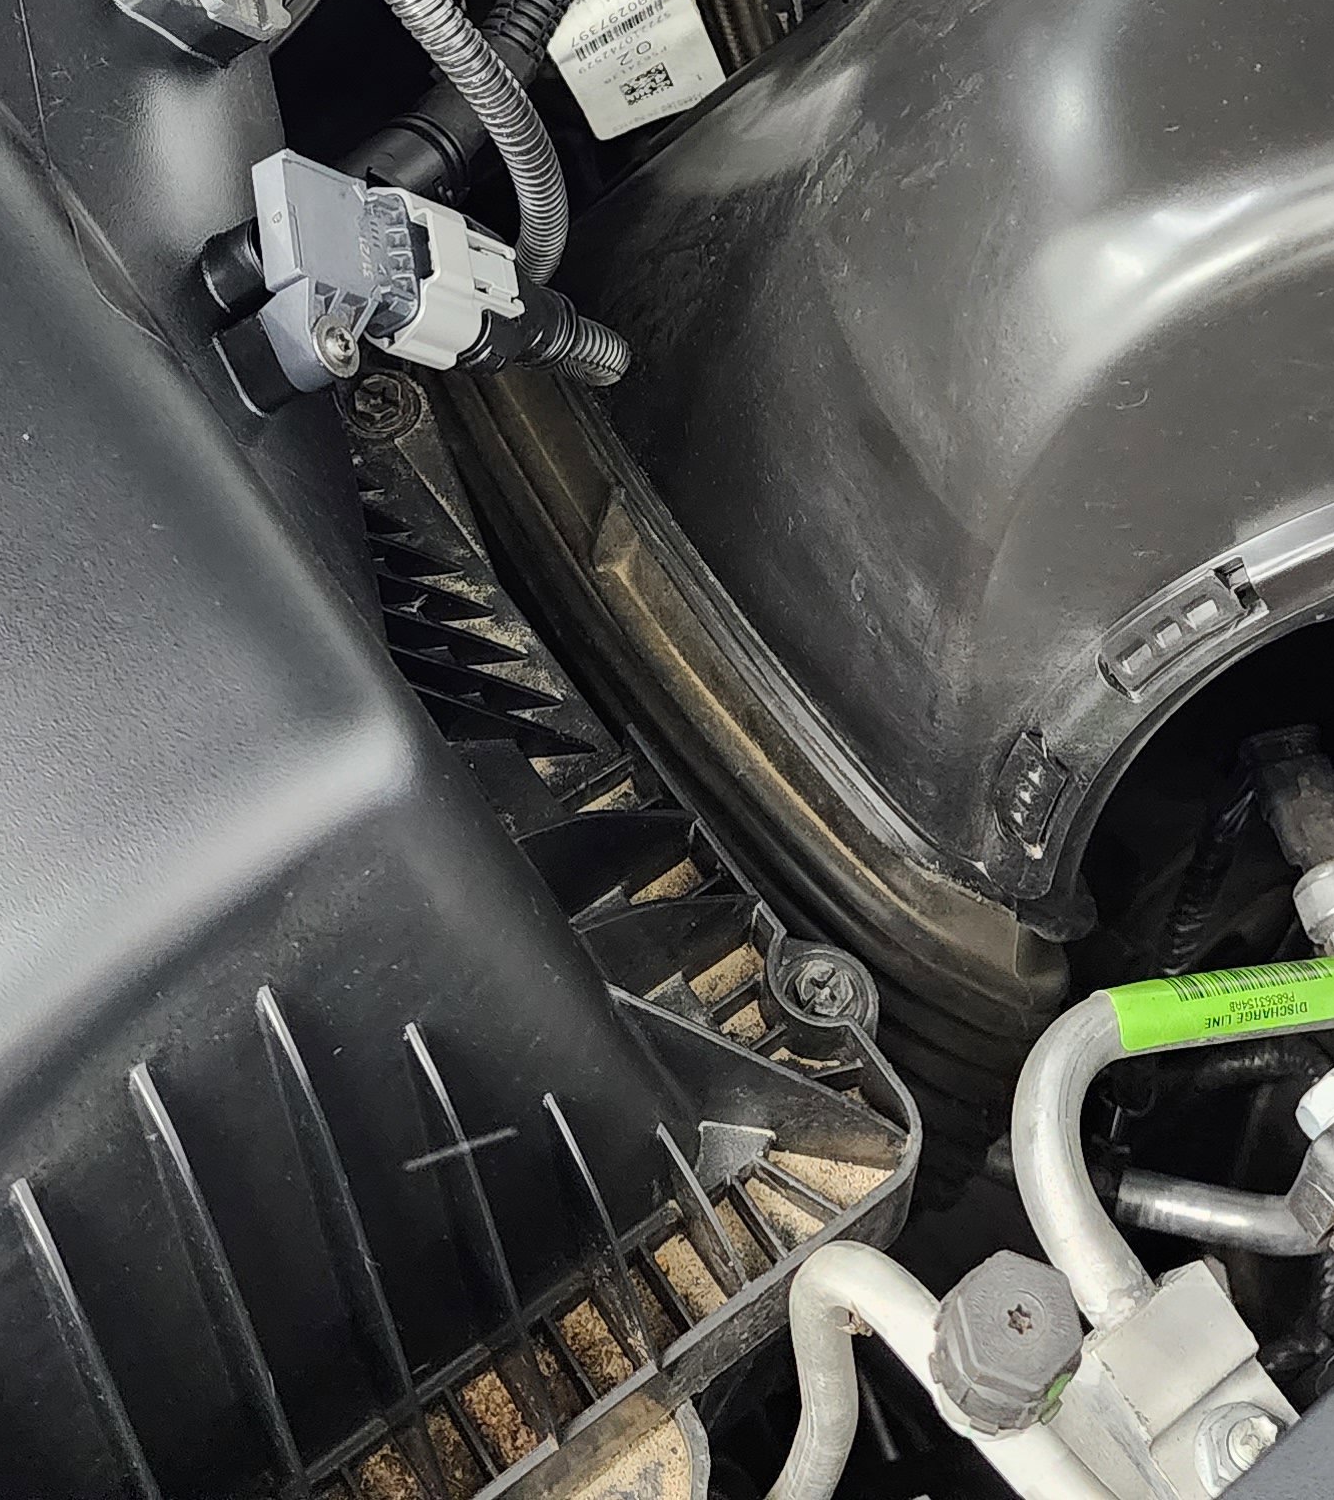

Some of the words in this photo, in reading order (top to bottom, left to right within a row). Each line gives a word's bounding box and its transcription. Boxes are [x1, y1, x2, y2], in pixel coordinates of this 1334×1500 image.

[1229, 991, 1296, 1013] P68363154AB
[1236, 1001, 1308, 1024] DISCHARGE
[1204, 1014, 1232, 1029] LINE
